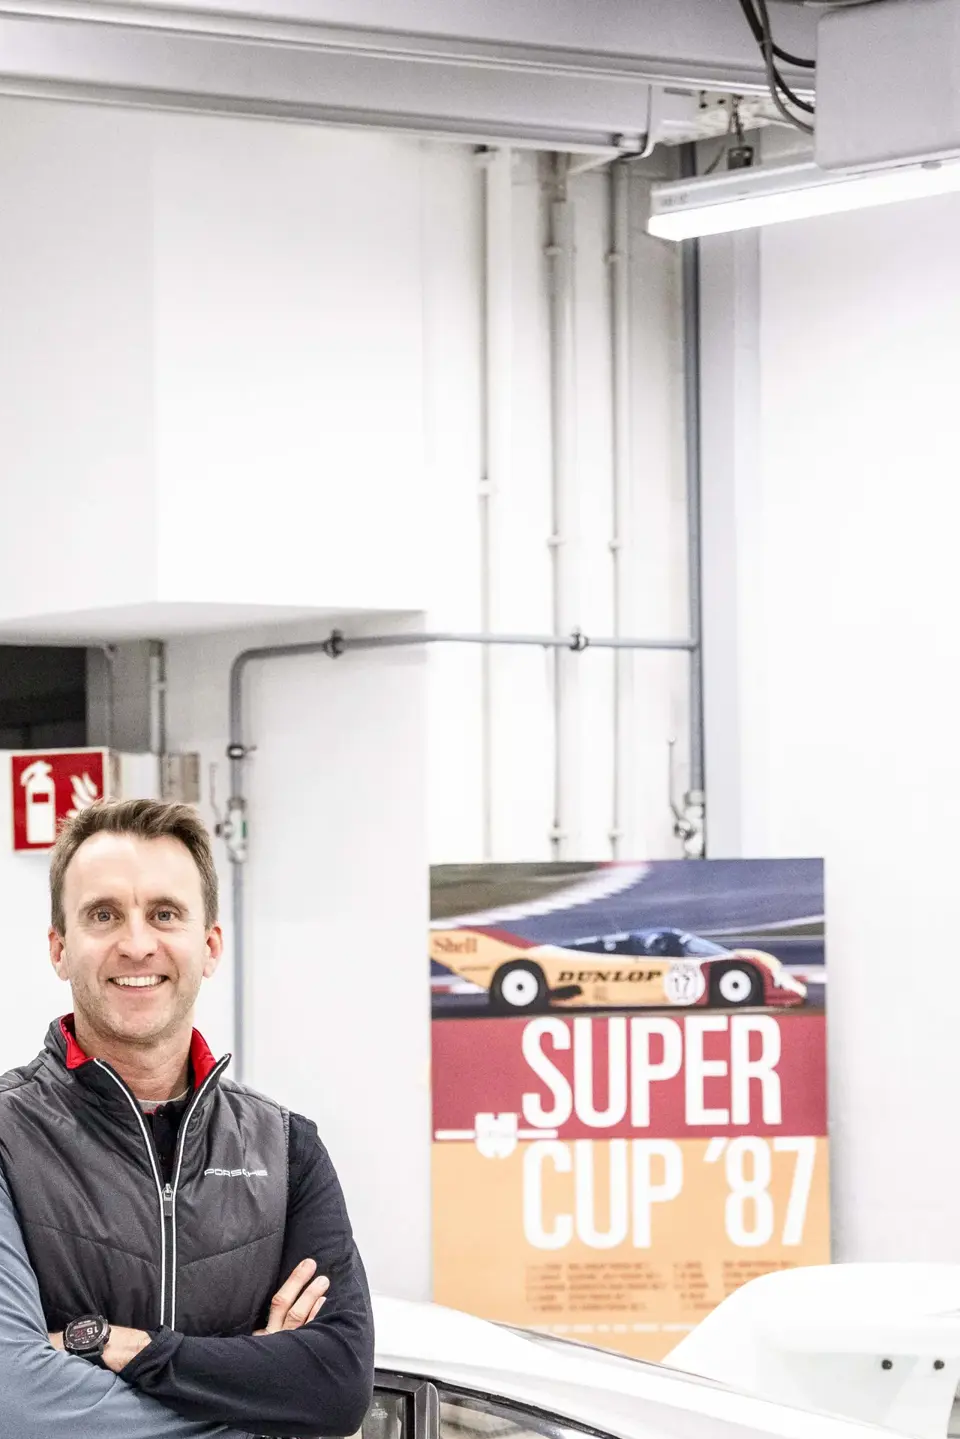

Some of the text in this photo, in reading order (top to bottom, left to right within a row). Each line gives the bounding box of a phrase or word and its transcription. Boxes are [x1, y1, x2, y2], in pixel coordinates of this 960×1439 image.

[433, 937, 478, 954] Shell
[558, 969, 662, 984] DUNLOP
[521, 1014, 782, 1130] SUPER
[523, 1136, 817, 1250] CUP '87
